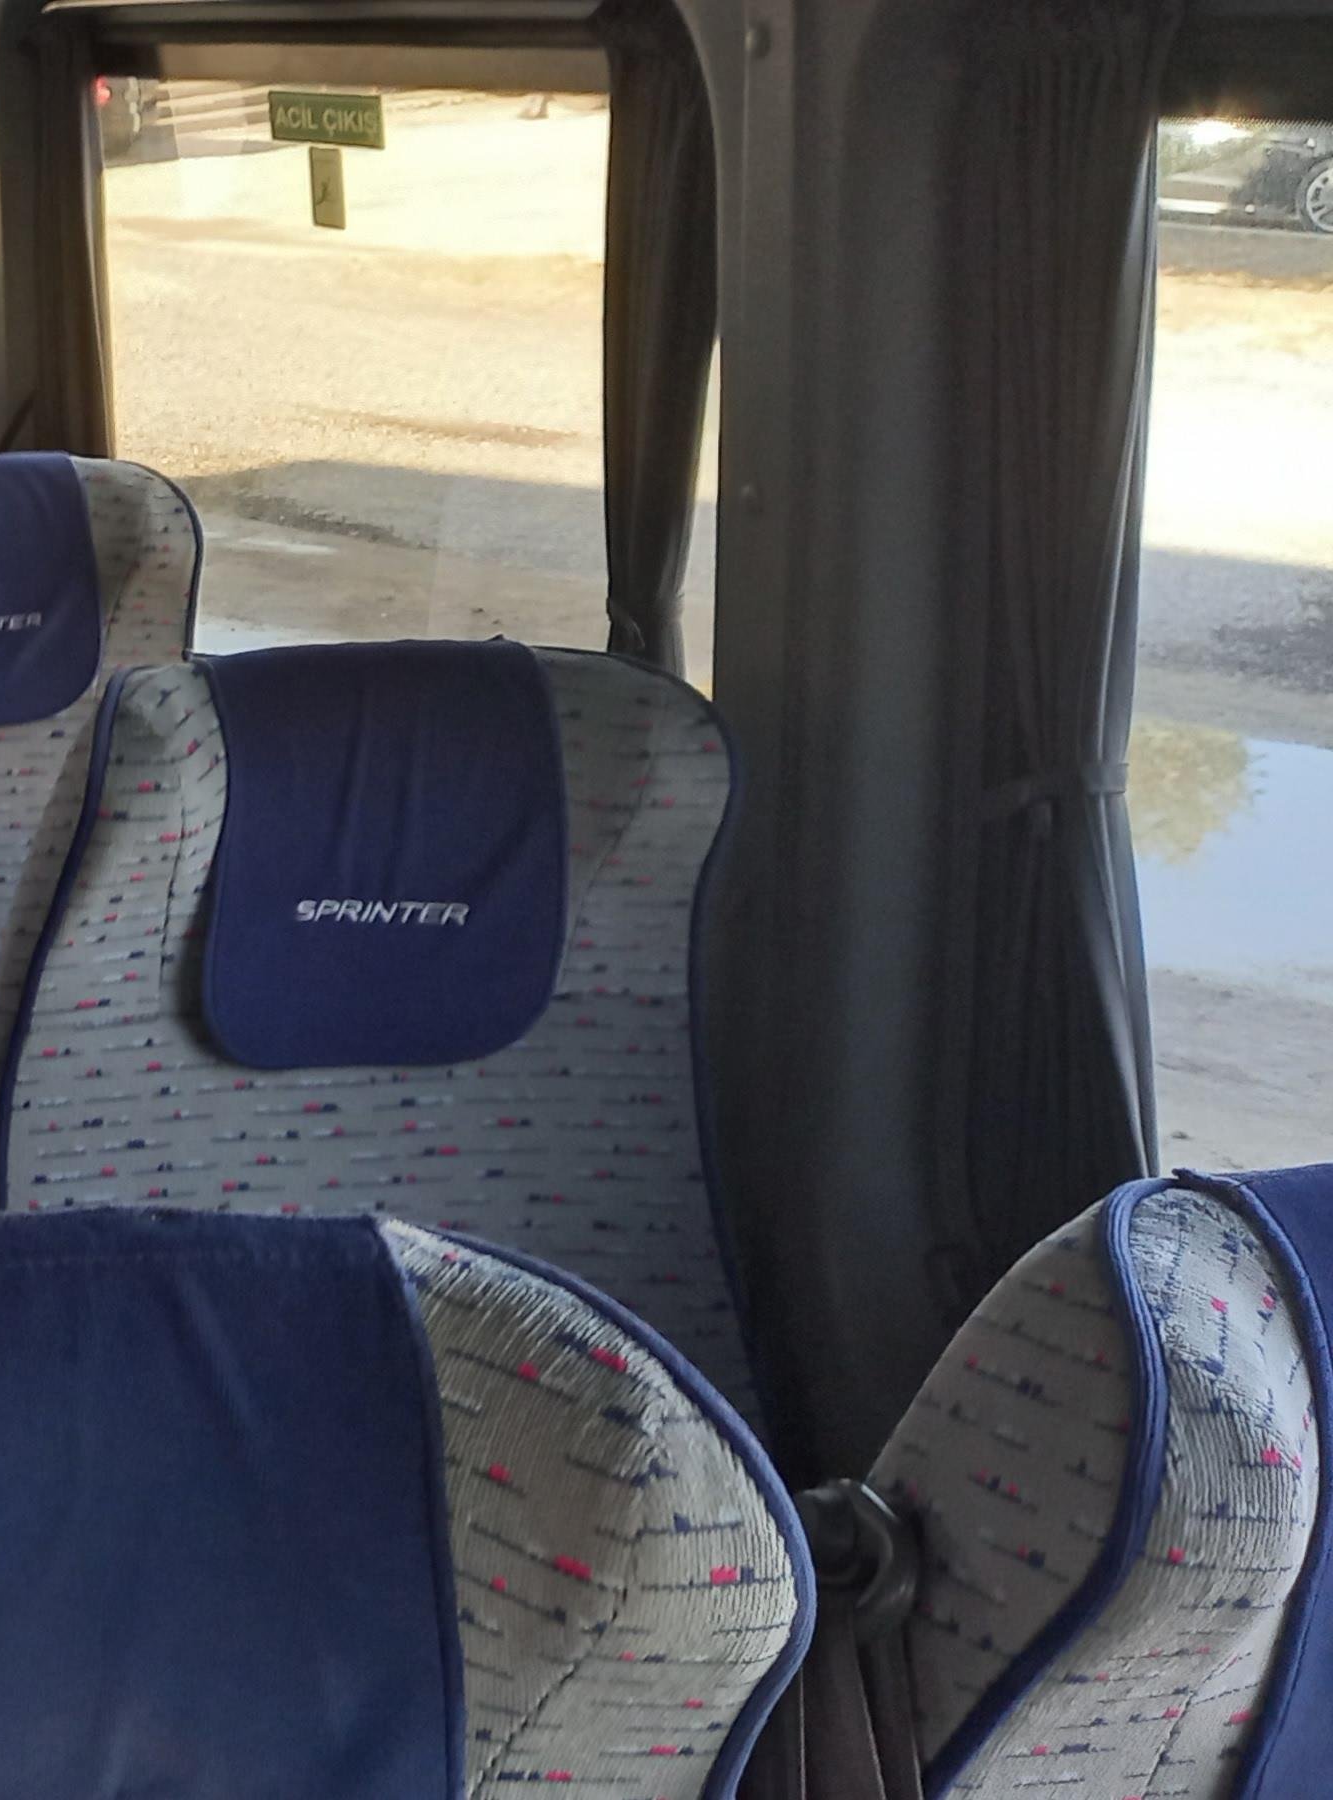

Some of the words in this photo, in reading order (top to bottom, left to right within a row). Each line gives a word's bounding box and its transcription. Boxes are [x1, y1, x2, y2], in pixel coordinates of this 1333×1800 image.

[274, 101, 318, 130] ACİL
[322, 107, 378, 138] ÇIKIŞ
[295, 899, 470, 927] SPRINTER
